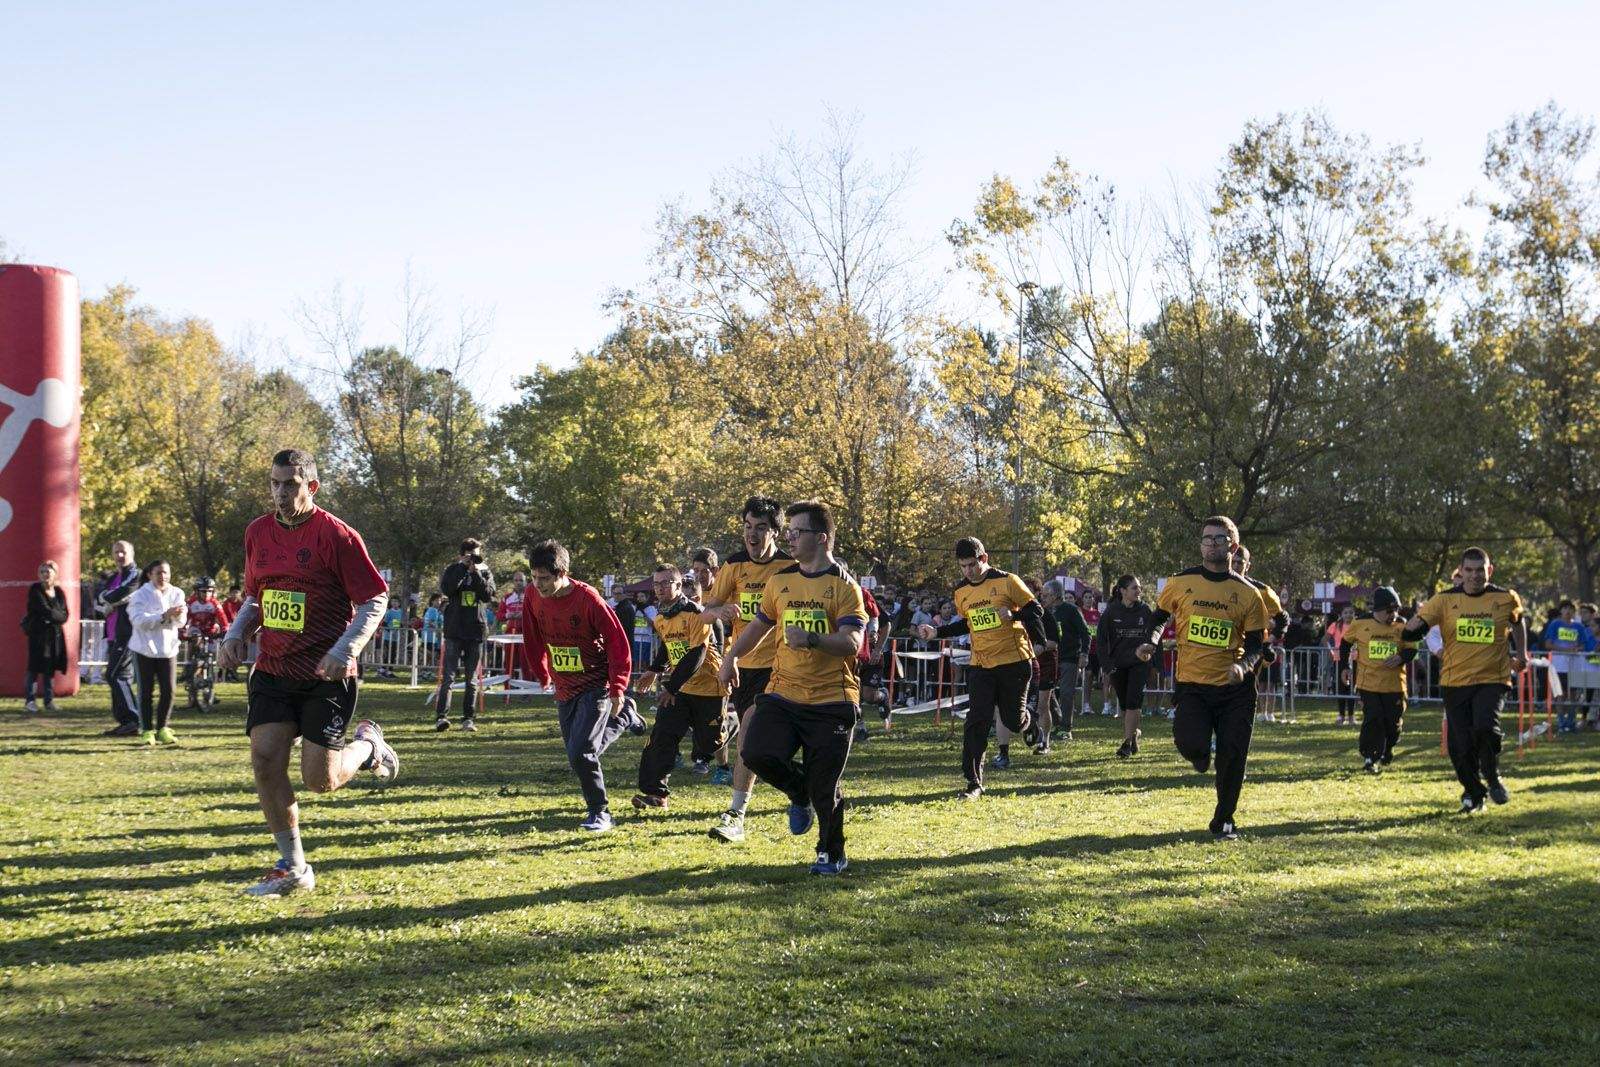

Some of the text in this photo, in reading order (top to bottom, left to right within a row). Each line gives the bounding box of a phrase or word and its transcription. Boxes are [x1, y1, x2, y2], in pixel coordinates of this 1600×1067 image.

[745, 582, 766, 590] ASM
[264, 600, 302, 622] 5083
[742, 601, 760, 615] 50
[972, 612, 996, 626] 5067
[1190, 622, 1228, 640] 5069
[1458, 625, 1492, 638] 5072
[554, 654, 579, 667] 077
